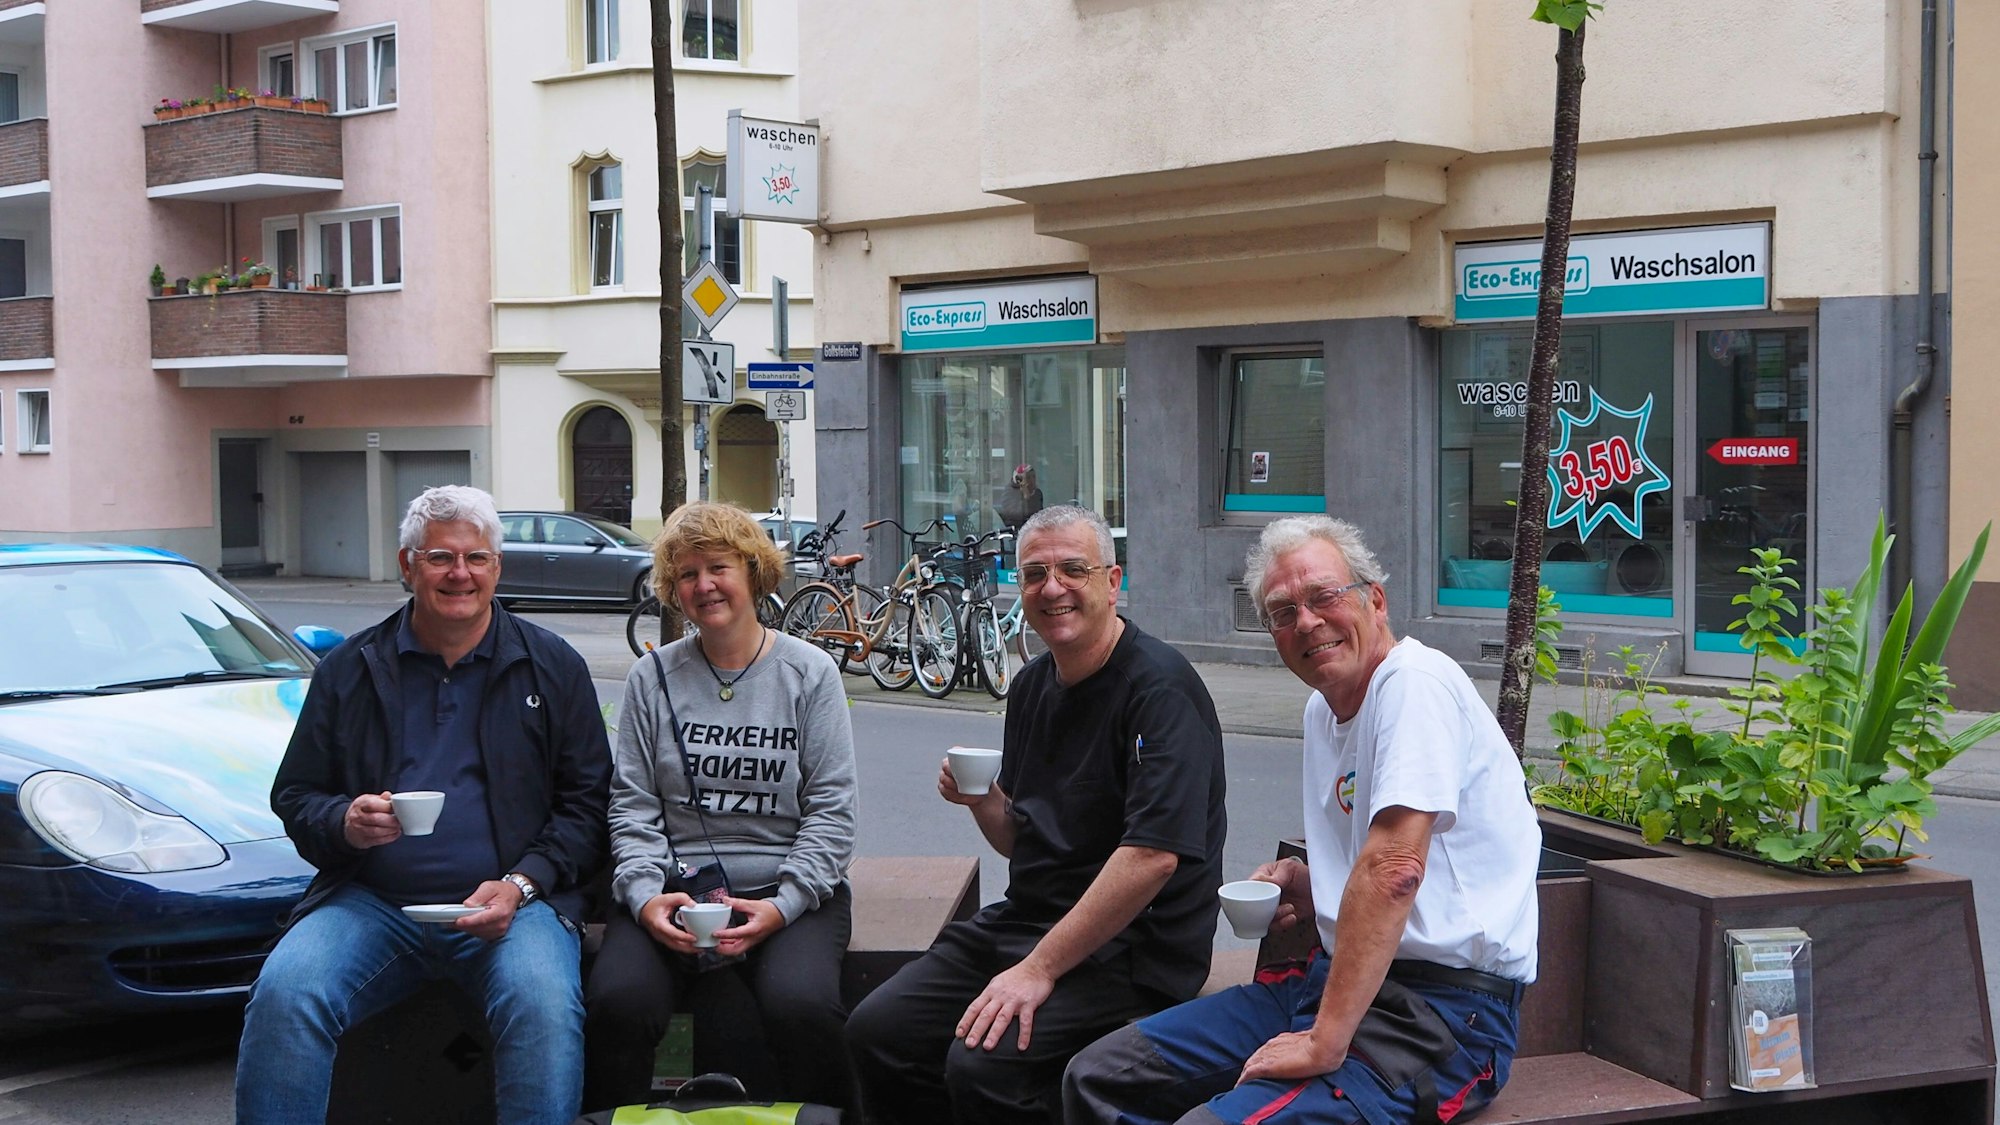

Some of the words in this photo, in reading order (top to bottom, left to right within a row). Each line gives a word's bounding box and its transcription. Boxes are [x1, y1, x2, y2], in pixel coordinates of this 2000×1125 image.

[746, 126, 816, 146] waschen
[768, 142, 781, 150] 6-10
[1468, 266, 1583, 290] Eco-Expss
[1610, 249, 1755, 280] Waschsalon
[909, 309, 983, 328] Eco-Express
[998, 297, 1088, 321] Waschsalon
[751, 372, 801, 380] Einbahnstraße
[1457, 380, 1581, 404] wascen
[1493, 404, 1517, 418] 6-10
[1722, 445, 1790, 458] EINGANG
